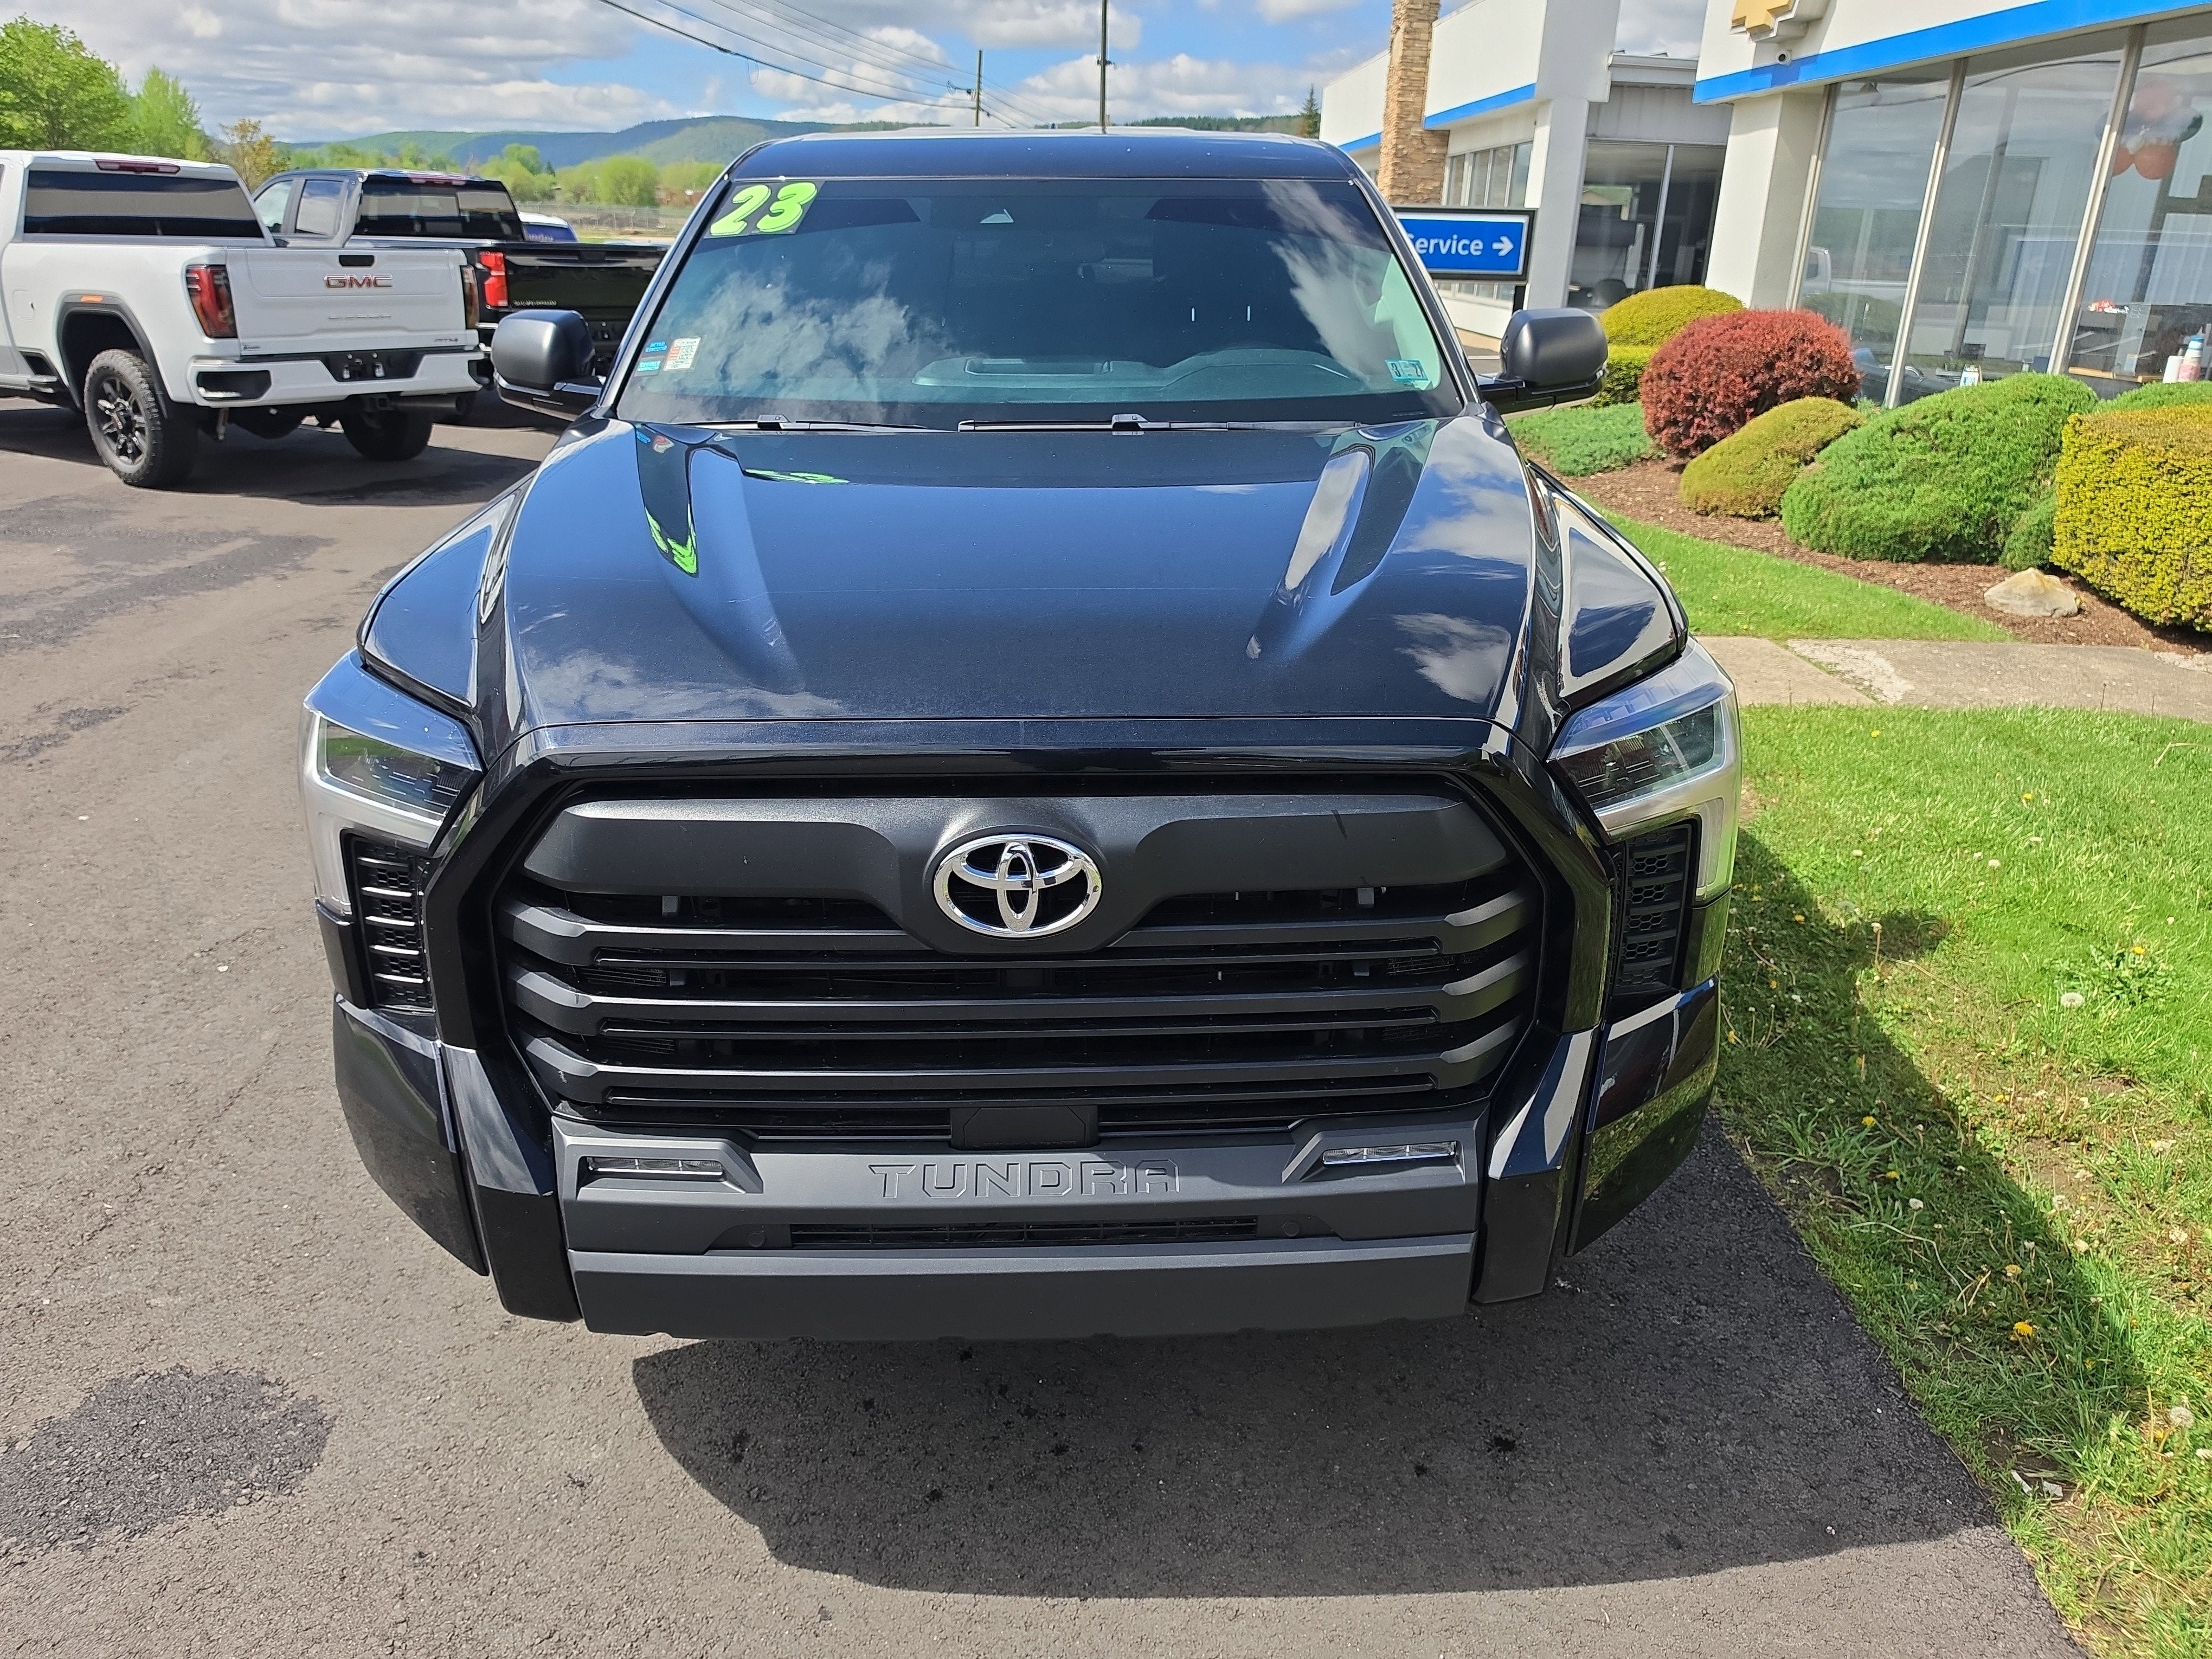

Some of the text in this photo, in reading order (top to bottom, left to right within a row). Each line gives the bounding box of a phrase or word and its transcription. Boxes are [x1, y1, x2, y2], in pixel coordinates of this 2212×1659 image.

[710, 182, 818, 236] 23
[1407, 233, 1484, 256] ervice
[324, 273, 393, 289] GMC
[868, 1159, 1180, 1198] TUNDRA
